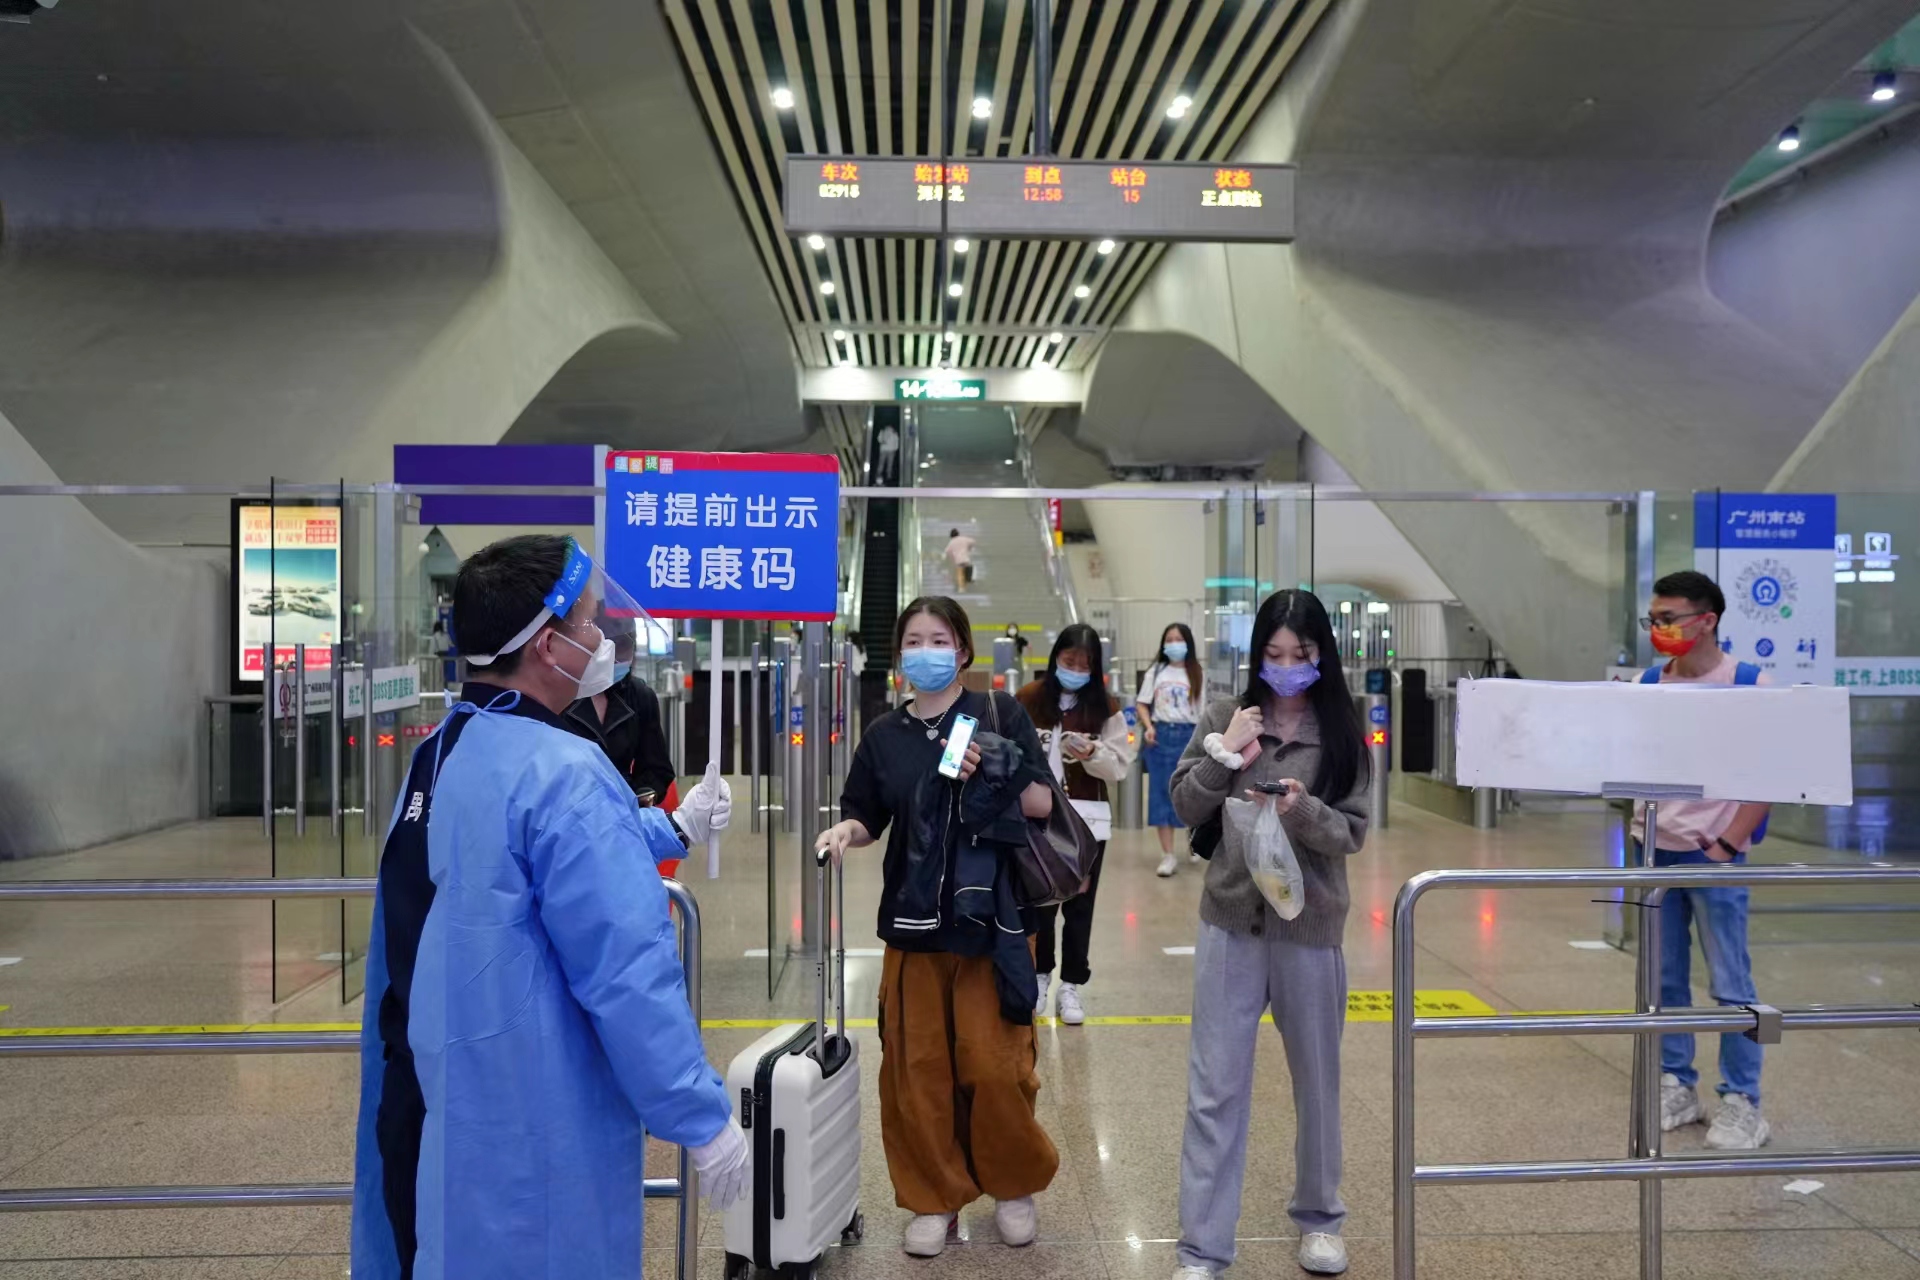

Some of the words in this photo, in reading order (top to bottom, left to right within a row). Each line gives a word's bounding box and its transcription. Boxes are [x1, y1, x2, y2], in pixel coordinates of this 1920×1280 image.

[822, 162, 859, 181] 车次
[915, 163, 969, 183] 始发站
[1024, 166, 1061, 185] 到点
[1110, 167, 1147, 186] 站台
[1214, 168, 1252, 188] 状态
[1024, 188, 1062, 201] 12:58
[1123, 189, 1141, 203] 15
[625, 490, 818, 528] 请提前出示
[1727, 510, 1806, 524] 广州南站
[646, 544, 795, 591] 健康码
